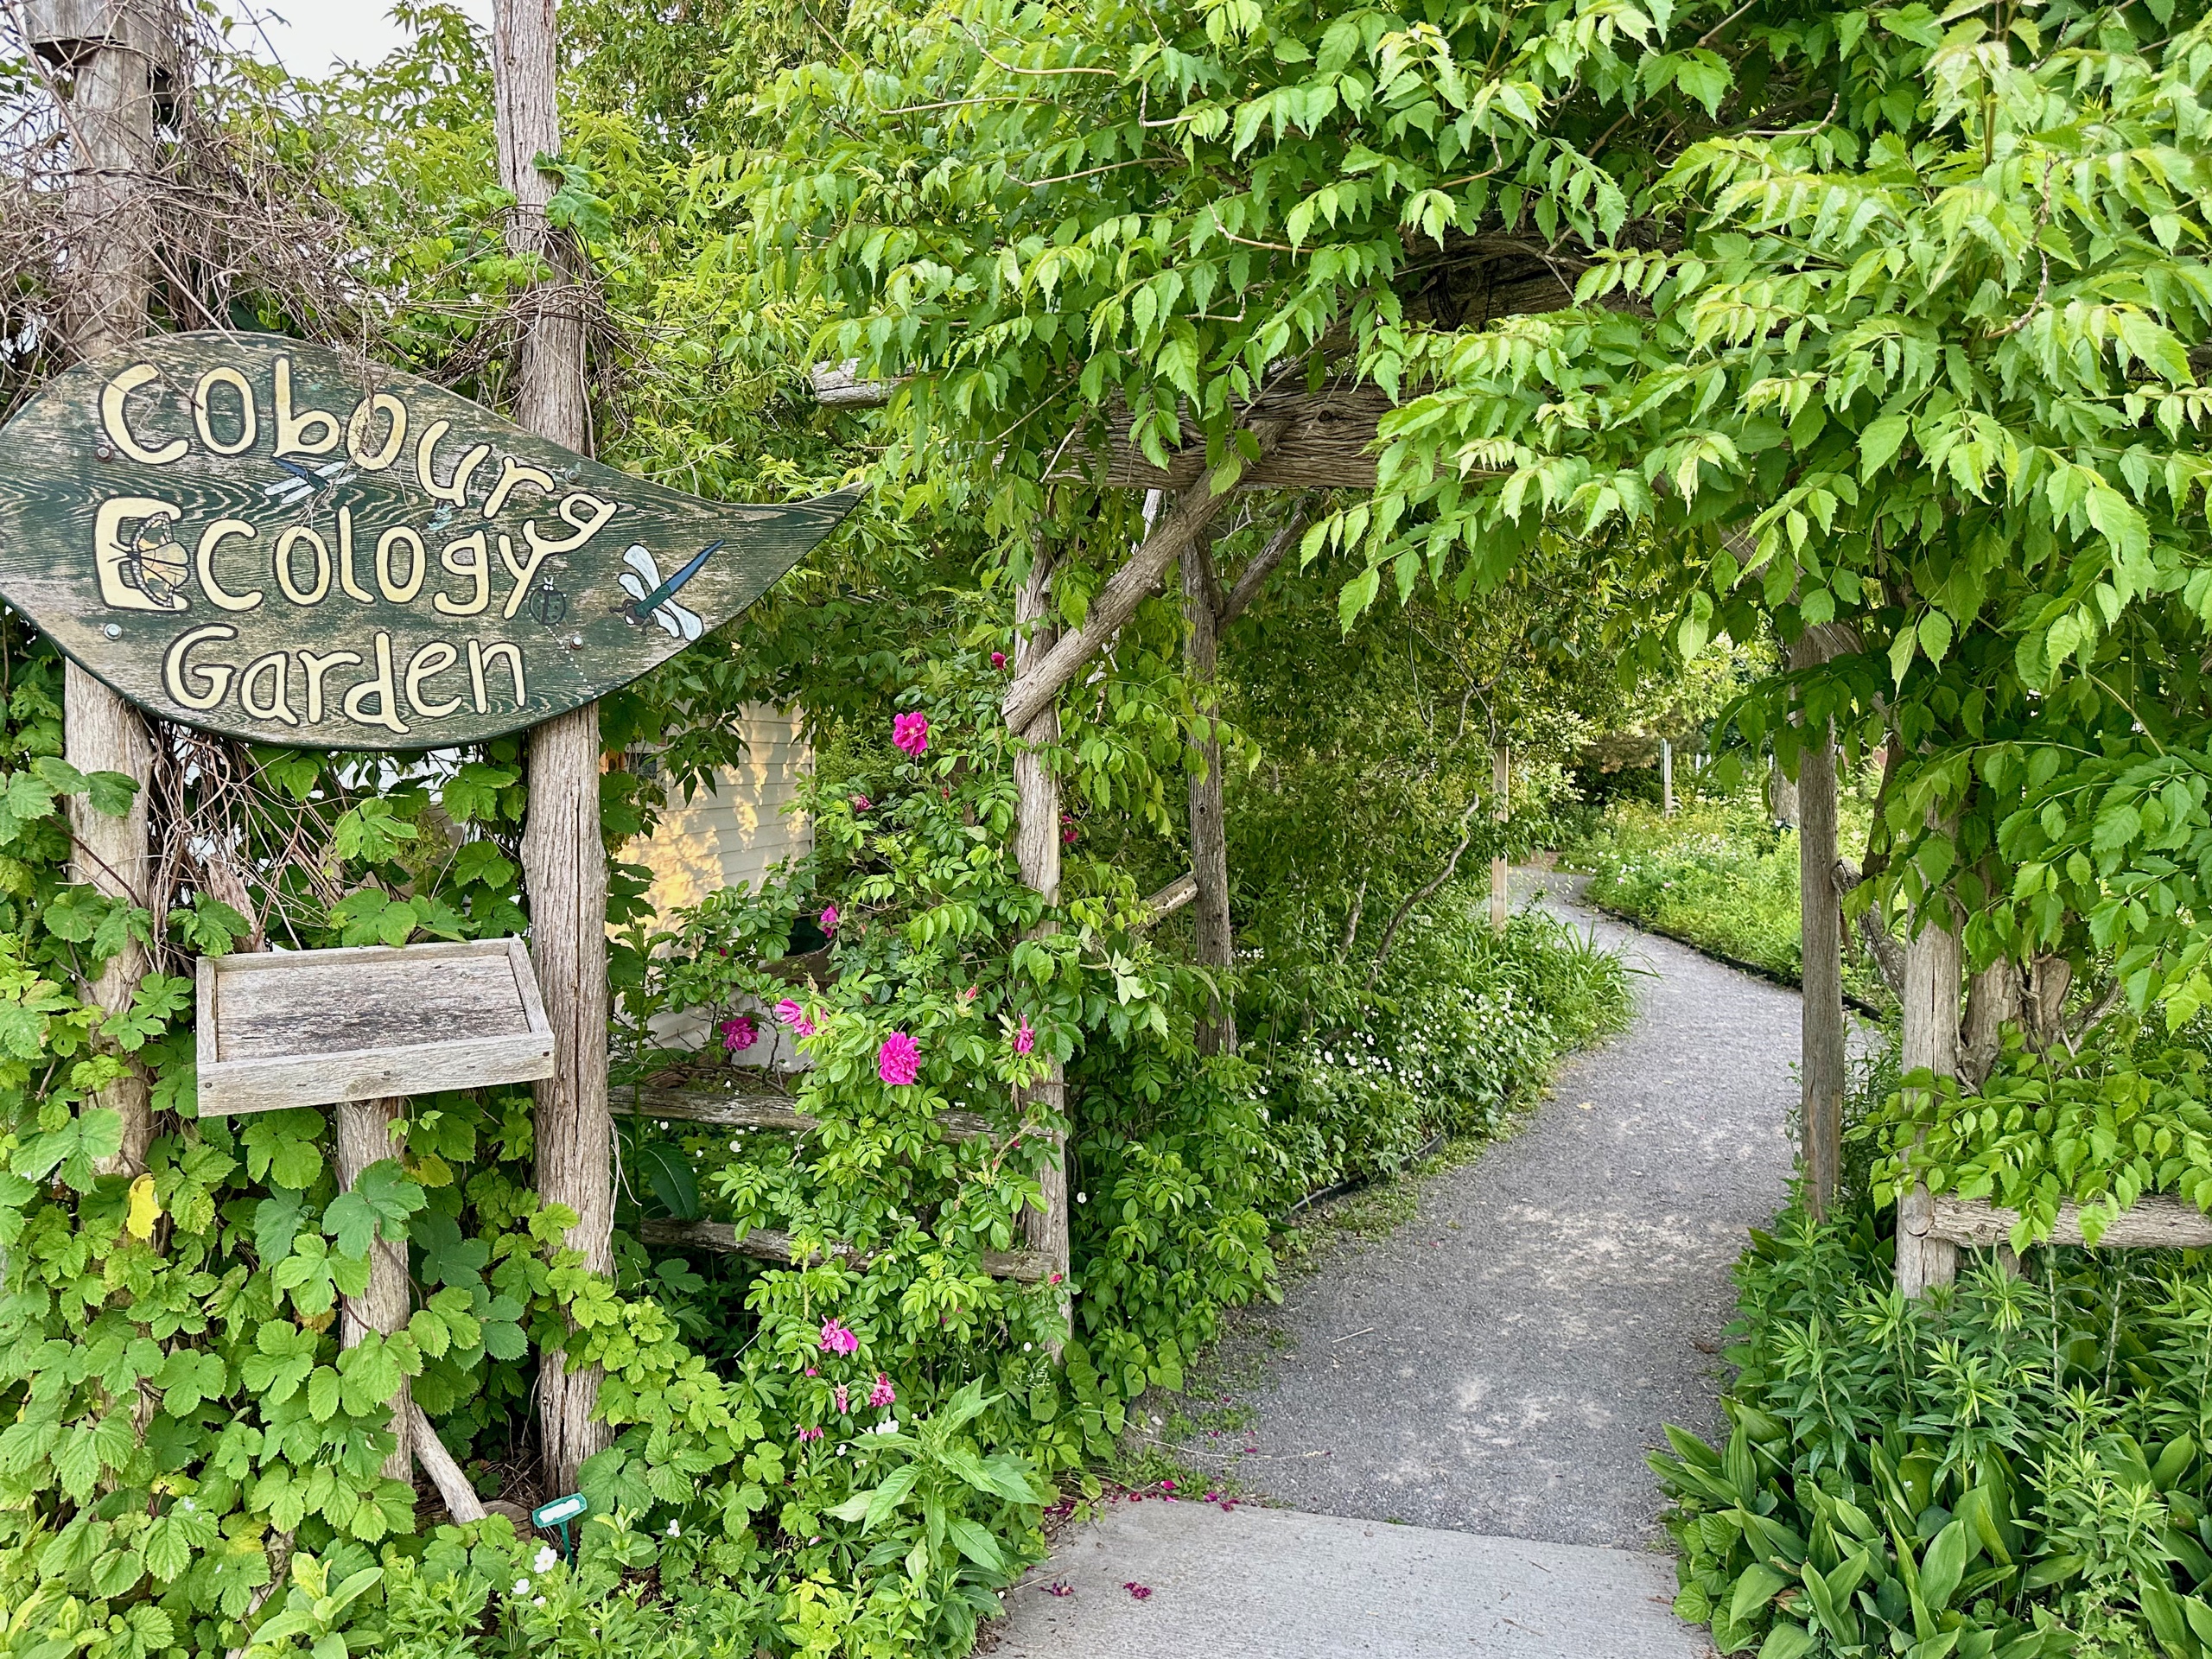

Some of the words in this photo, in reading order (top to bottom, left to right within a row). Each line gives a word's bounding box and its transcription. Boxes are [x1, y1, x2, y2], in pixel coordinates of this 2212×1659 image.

[99, 354, 619, 555] Cobourg
[92, 495, 553, 620] Ecology
[162, 622, 526, 734] Garden
